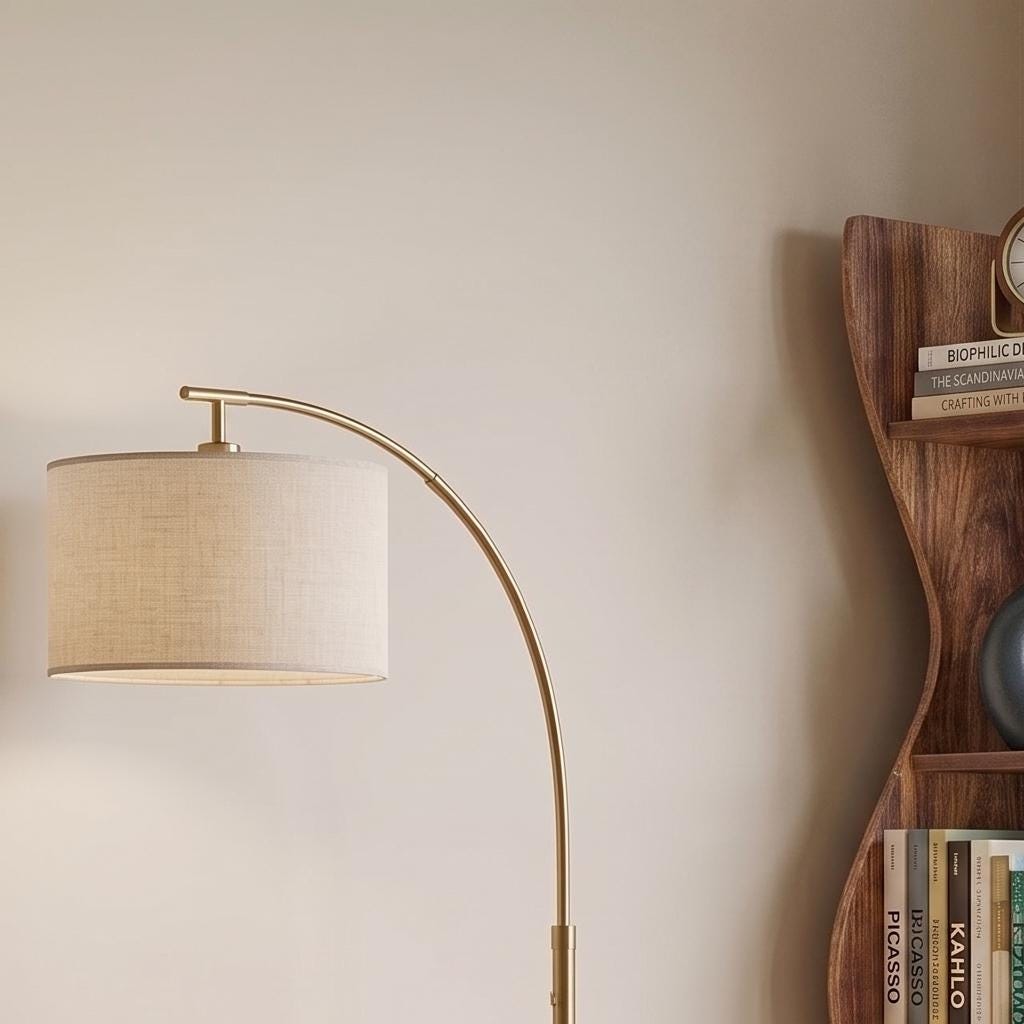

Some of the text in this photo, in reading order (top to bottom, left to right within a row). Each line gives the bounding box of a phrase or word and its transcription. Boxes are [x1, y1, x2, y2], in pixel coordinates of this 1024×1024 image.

[947, 343, 1010, 363] BIOPHILIC
[931, 374, 951, 389] THE
[941, 395, 991, 411] CRAFTING
[993, 392, 1019, 406] WITH
[887, 910, 900, 1004] PICASSO
[950, 922, 965, 1009] KAHLO
